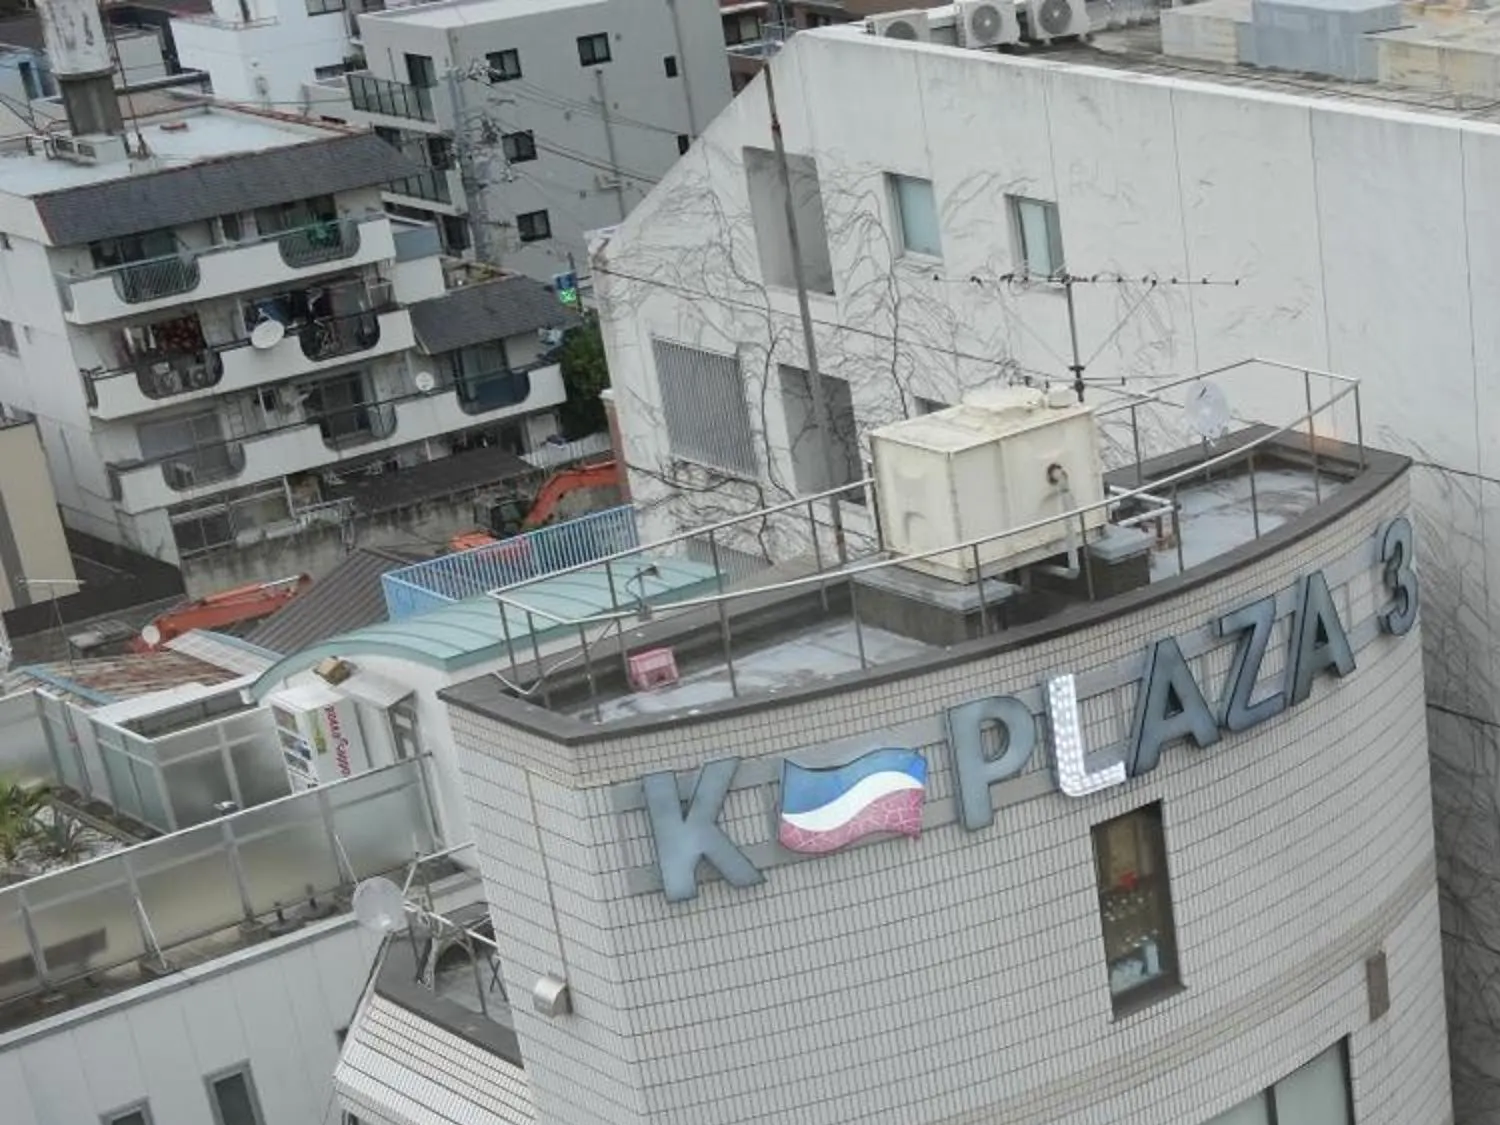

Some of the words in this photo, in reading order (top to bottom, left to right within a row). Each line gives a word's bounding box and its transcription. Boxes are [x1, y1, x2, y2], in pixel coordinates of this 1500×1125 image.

[639, 755, 766, 903] K
[944, 569, 1358, 833] PLAZA
[1375, 515, 1418, 637] 3
